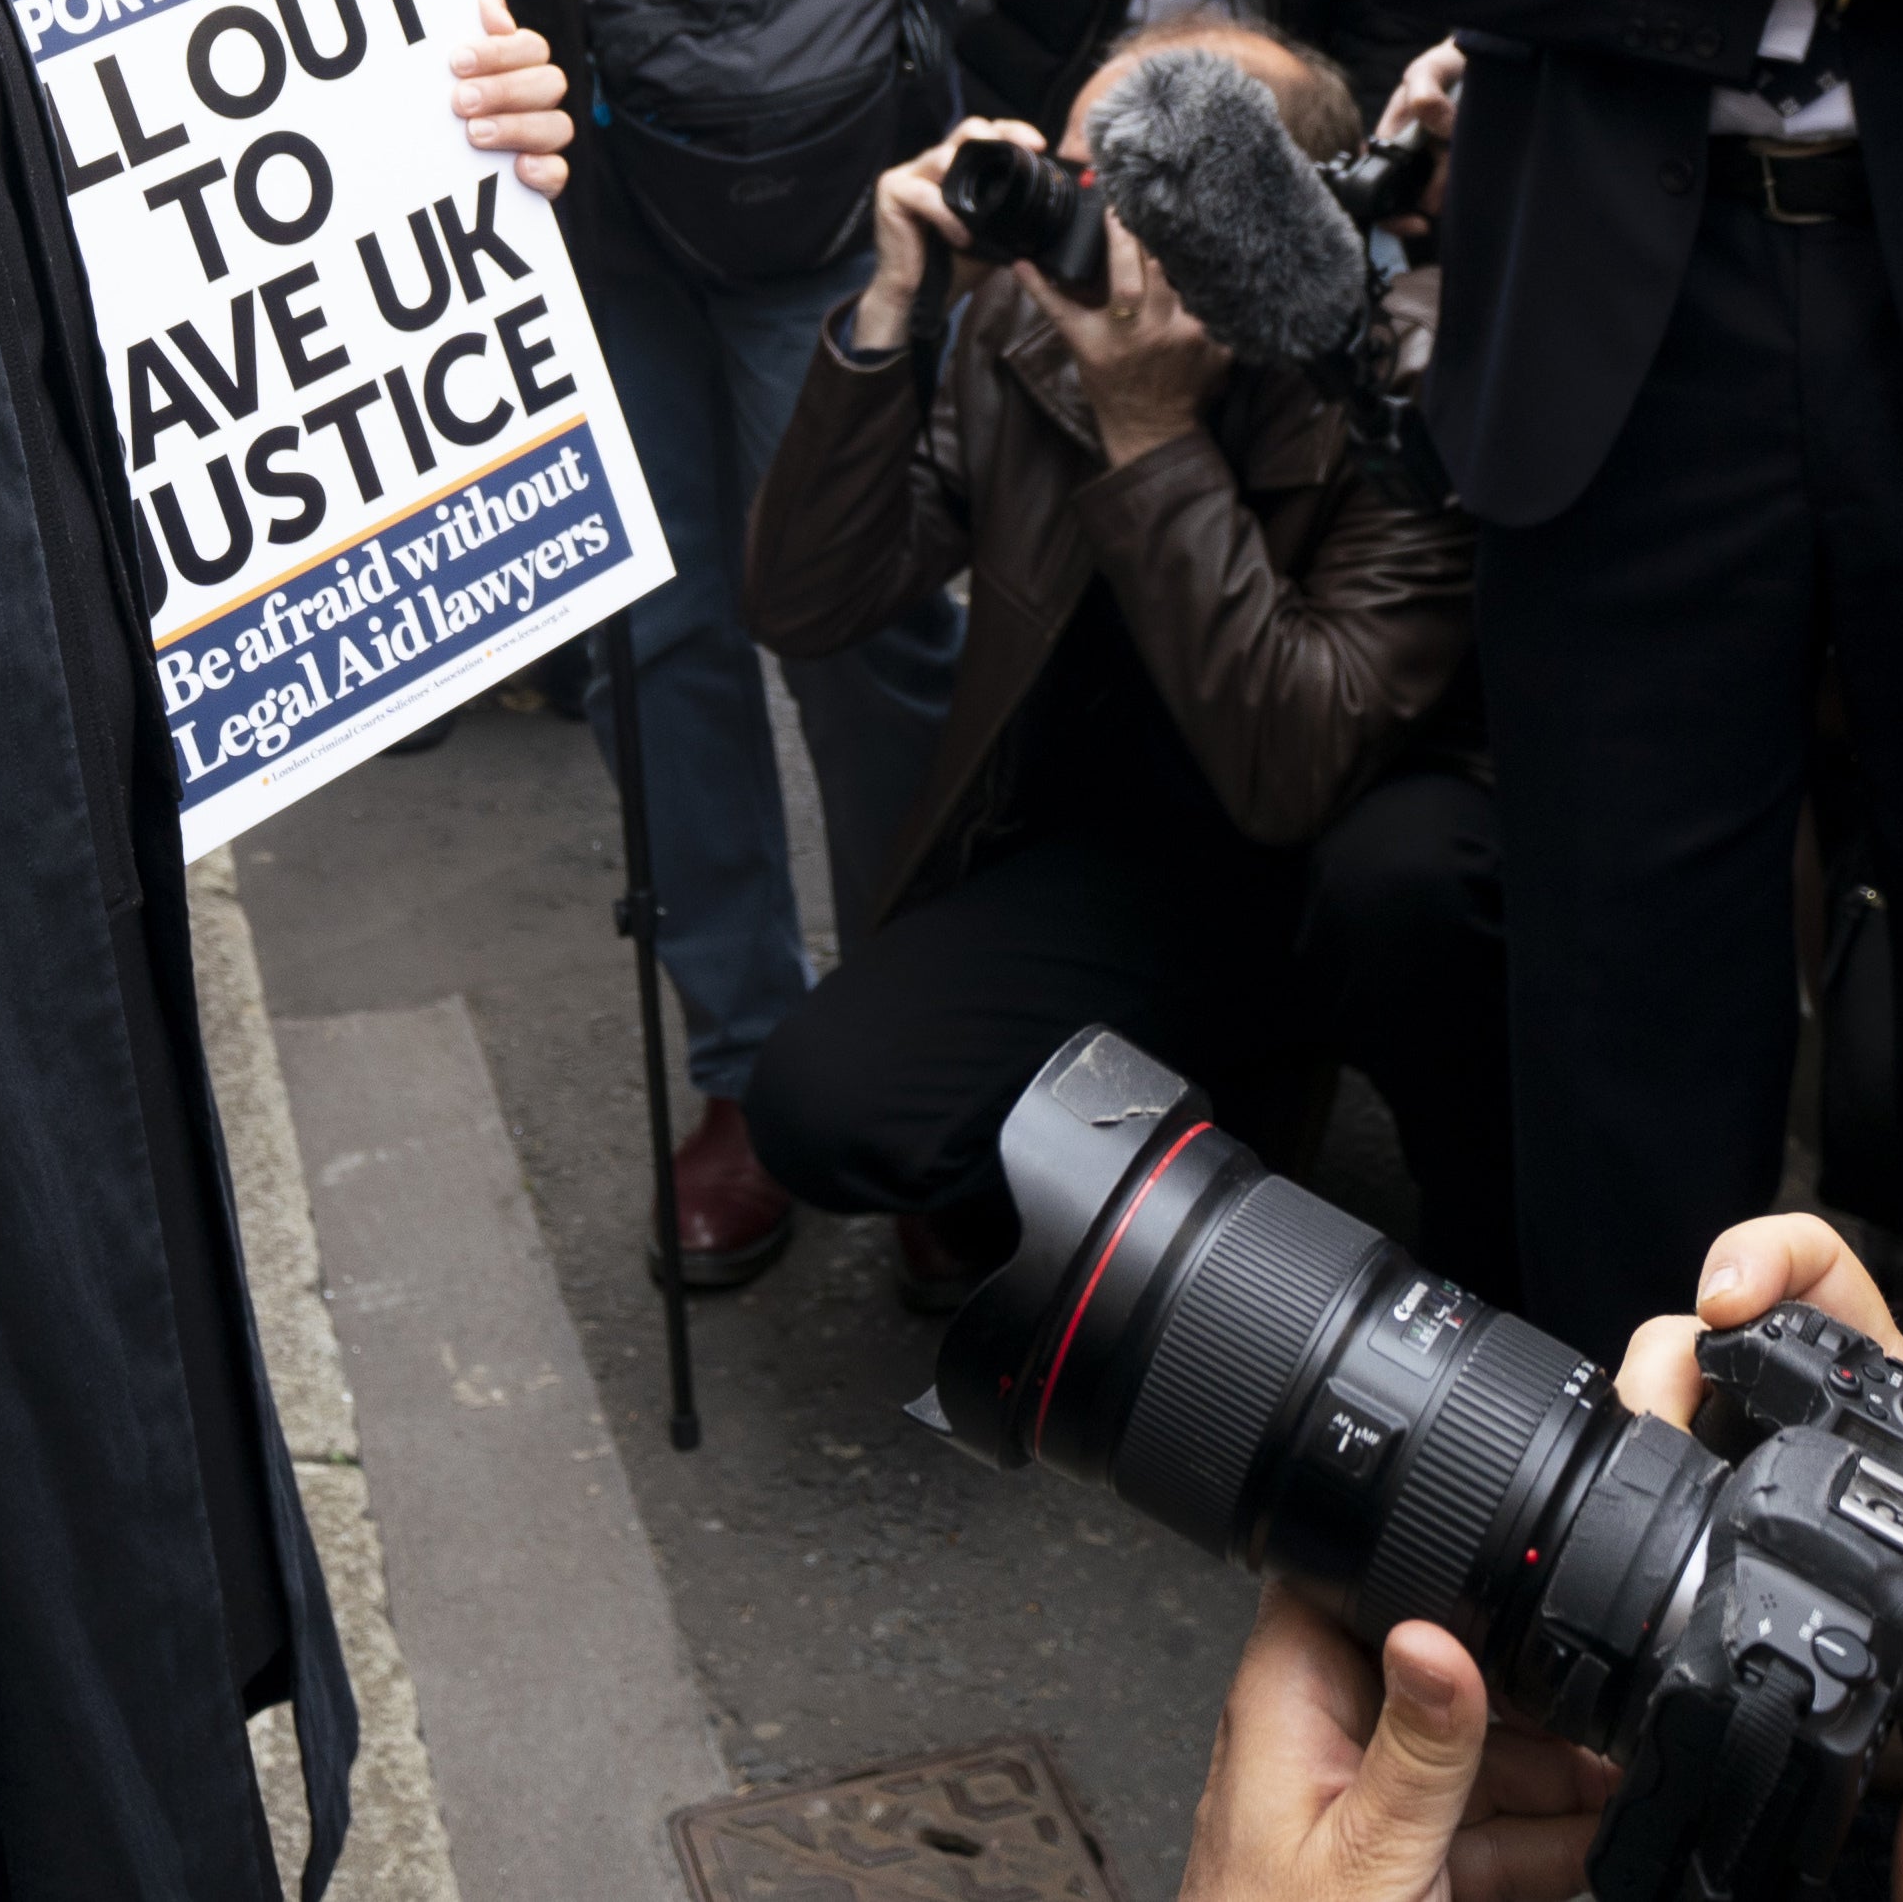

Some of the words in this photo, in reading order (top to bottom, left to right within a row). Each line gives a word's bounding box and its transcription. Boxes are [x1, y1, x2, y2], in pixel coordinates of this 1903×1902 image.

[42, 53, 191, 197] LL
[143, 130, 334, 283] TO
[127, 260, 351, 473] AVE
[355, 171, 534, 333] UK
[157, 648, 236, 718] Be
[234, 539, 401, 673] afraid
[390, 445, 591, 582] without
[170, 650, 334, 785] Legal
[333, 597, 434, 700] Aid
[428, 512, 612, 644] lawyers
[270, 754, 312, 783] London
[309, 728, 354, 760] Criminal
[352, 711, 387, 736] Courts
[430, 655, 485, 690] Association
